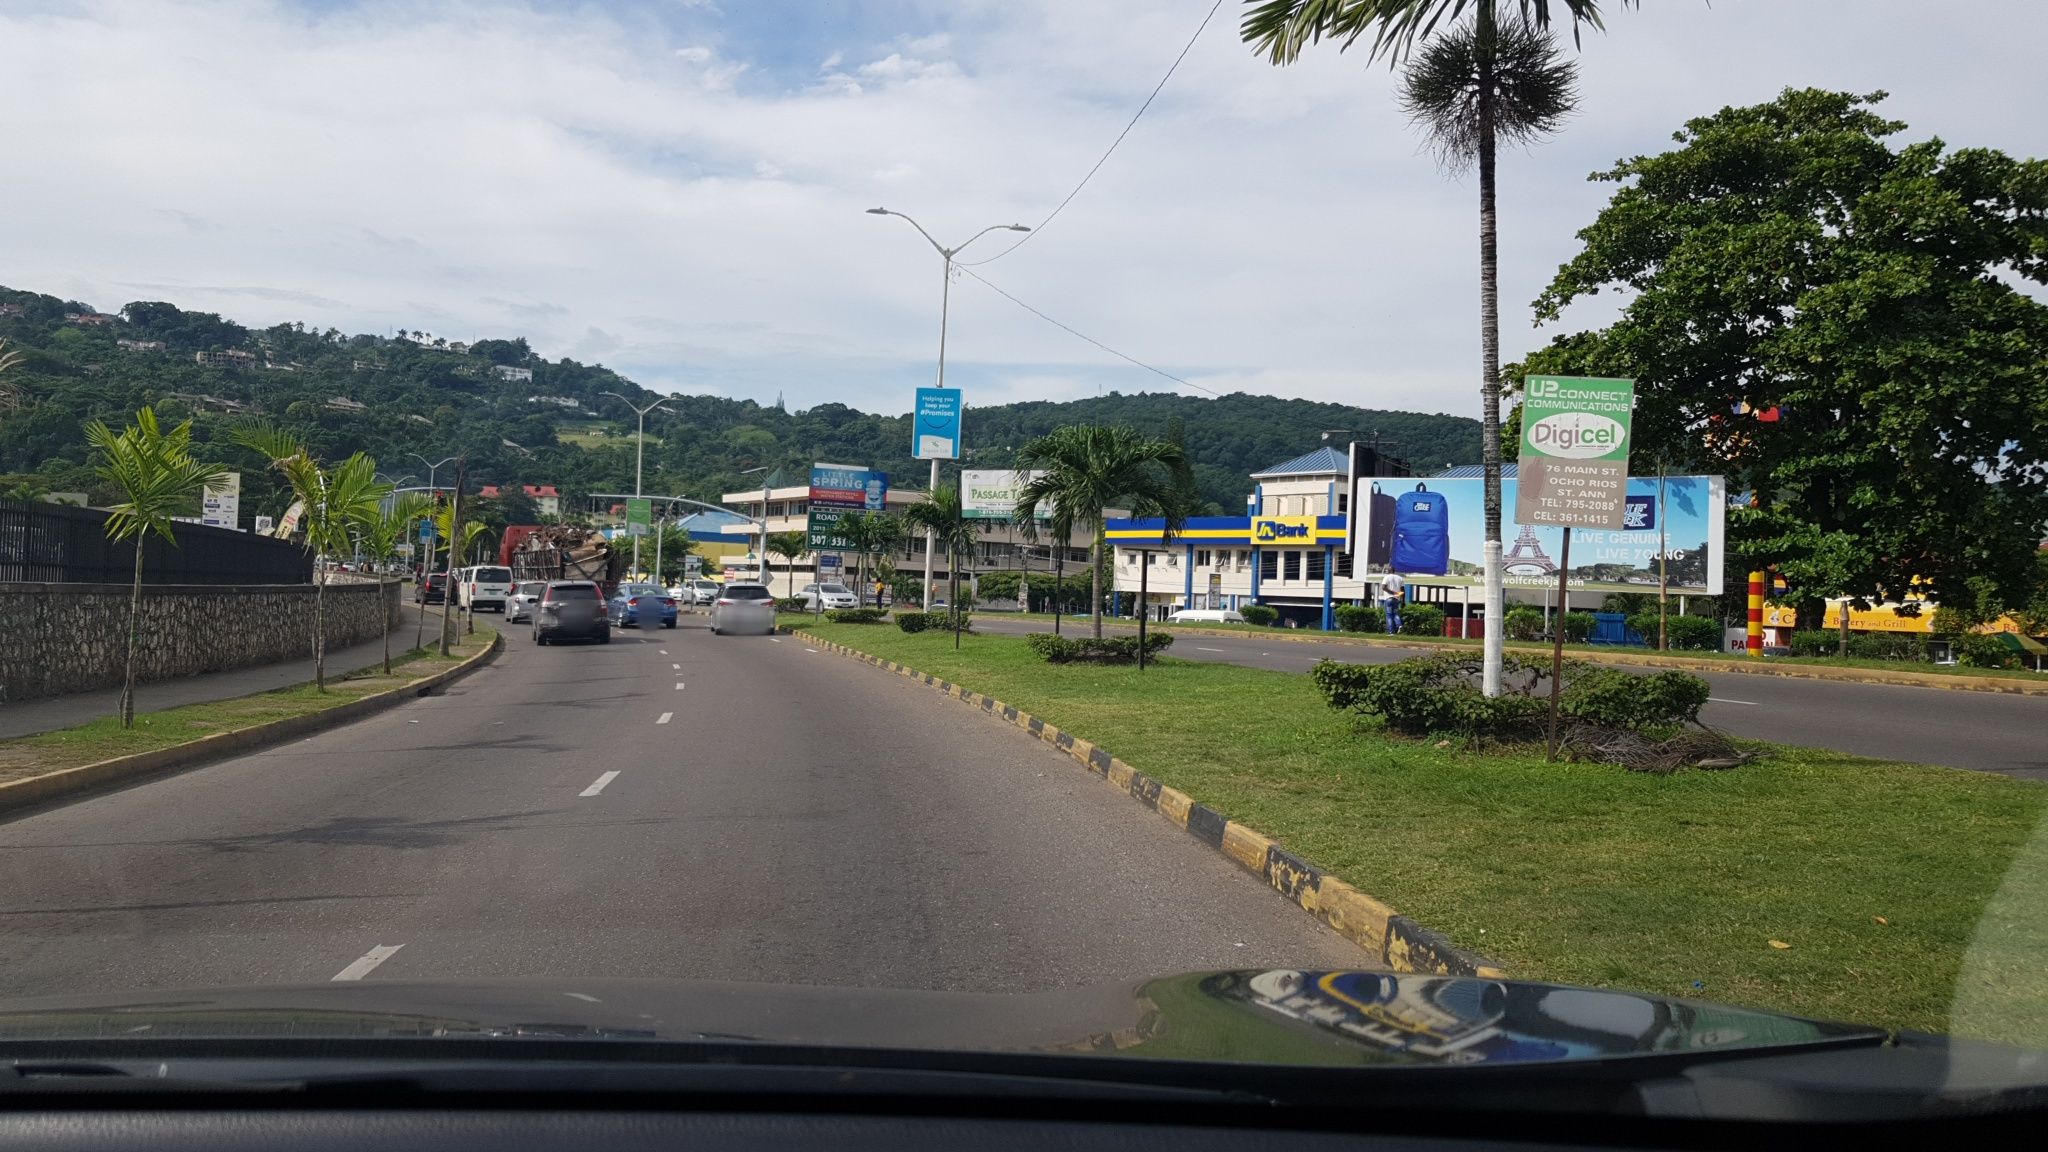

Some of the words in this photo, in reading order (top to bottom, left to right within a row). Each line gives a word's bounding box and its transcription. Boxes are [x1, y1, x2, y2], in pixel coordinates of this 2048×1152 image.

[1530, 380, 1559, 398] U2
[1559, 389, 1628, 401] CONNECT
[922, 395, 943, 403] Helping
[1527, 399, 1629, 412] COMMUNICATIONS
[920, 409, 954, 417] #Promises
[1535, 423, 1615, 450] Digicel
[822, 471, 855, 479] LITTLE
[1546, 464, 1560, 473] 76
[1564, 466, 1598, 475] MAIN
[1601, 468, 1620, 476] ST.
[813, 477, 863, 489] SPRING
[1549, 477, 1585, 487] OCHO
[1589, 480, 1618, 489] RIOS
[971, 489, 1009, 500] PASSAGE
[1557, 488, 1575, 497] ST.
[1579, 490, 1606, 499] ANN
[1541, 497, 1562, 508] TEL:
[815, 513, 838, 522] ROAD
[1534, 511, 1556, 521] CEL:
[1559, 513, 1609, 525] 361-1415
[1276, 523, 1309, 538] Bank
[811, 534, 827, 546] 307
[1572, 533, 1604, 544] LIVE
[1609, 533, 1671, 545] GENUINE
[1596, 548, 1629, 560] LIVE
[1833, 617, 1866, 627] Bery
[1884, 619, 1906, 628] Grill
